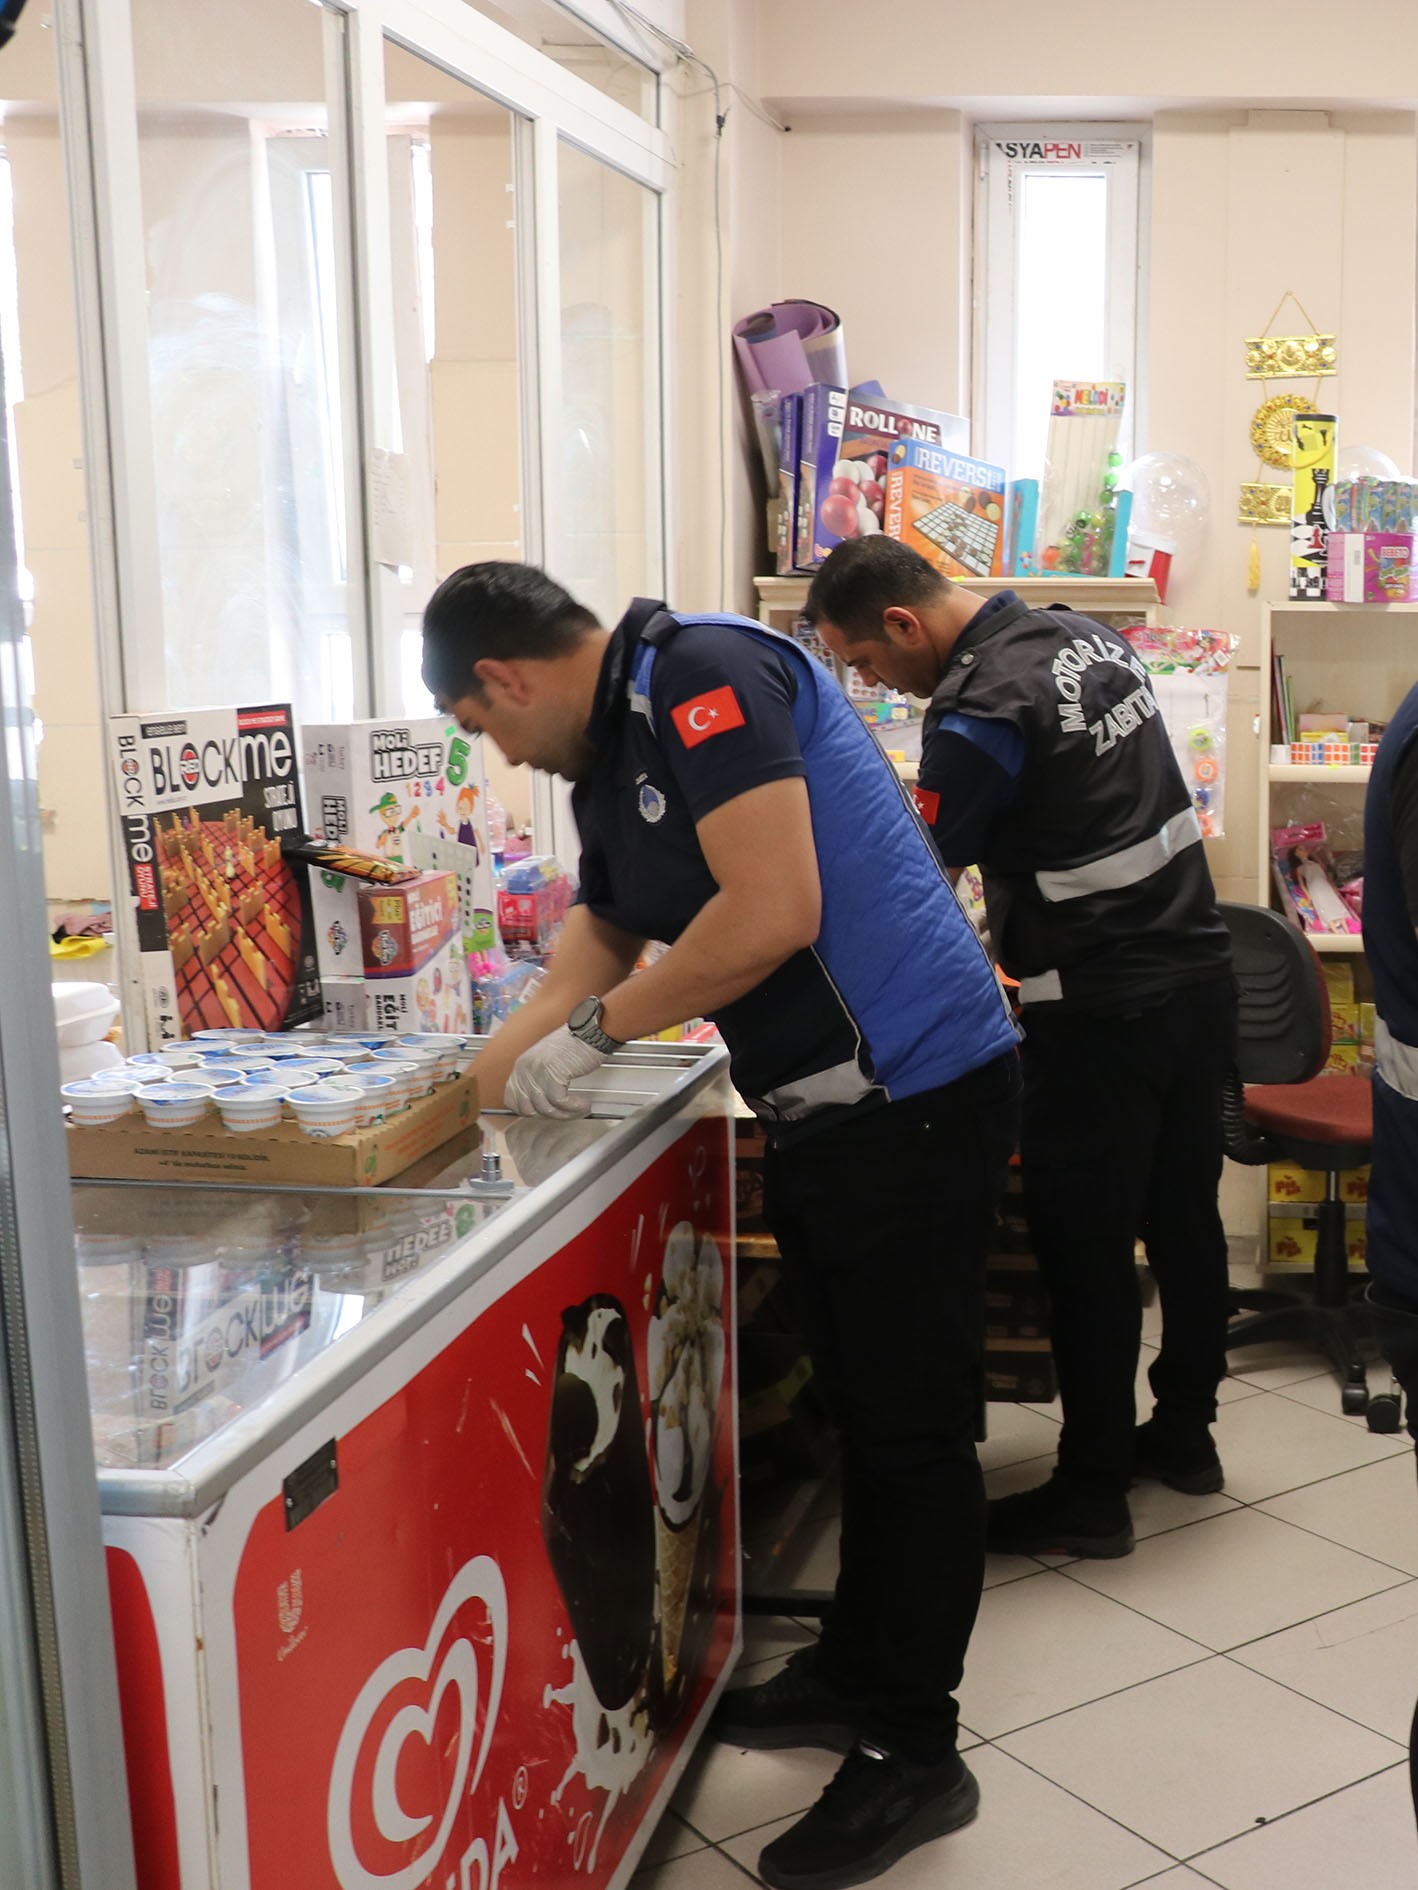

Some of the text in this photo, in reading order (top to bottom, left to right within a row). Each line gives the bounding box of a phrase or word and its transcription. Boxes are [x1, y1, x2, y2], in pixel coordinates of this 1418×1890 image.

[849, 406, 899, 435] ROLL
[371, 743, 444, 784] HEDEF
[447, 737, 471, 786] 5
